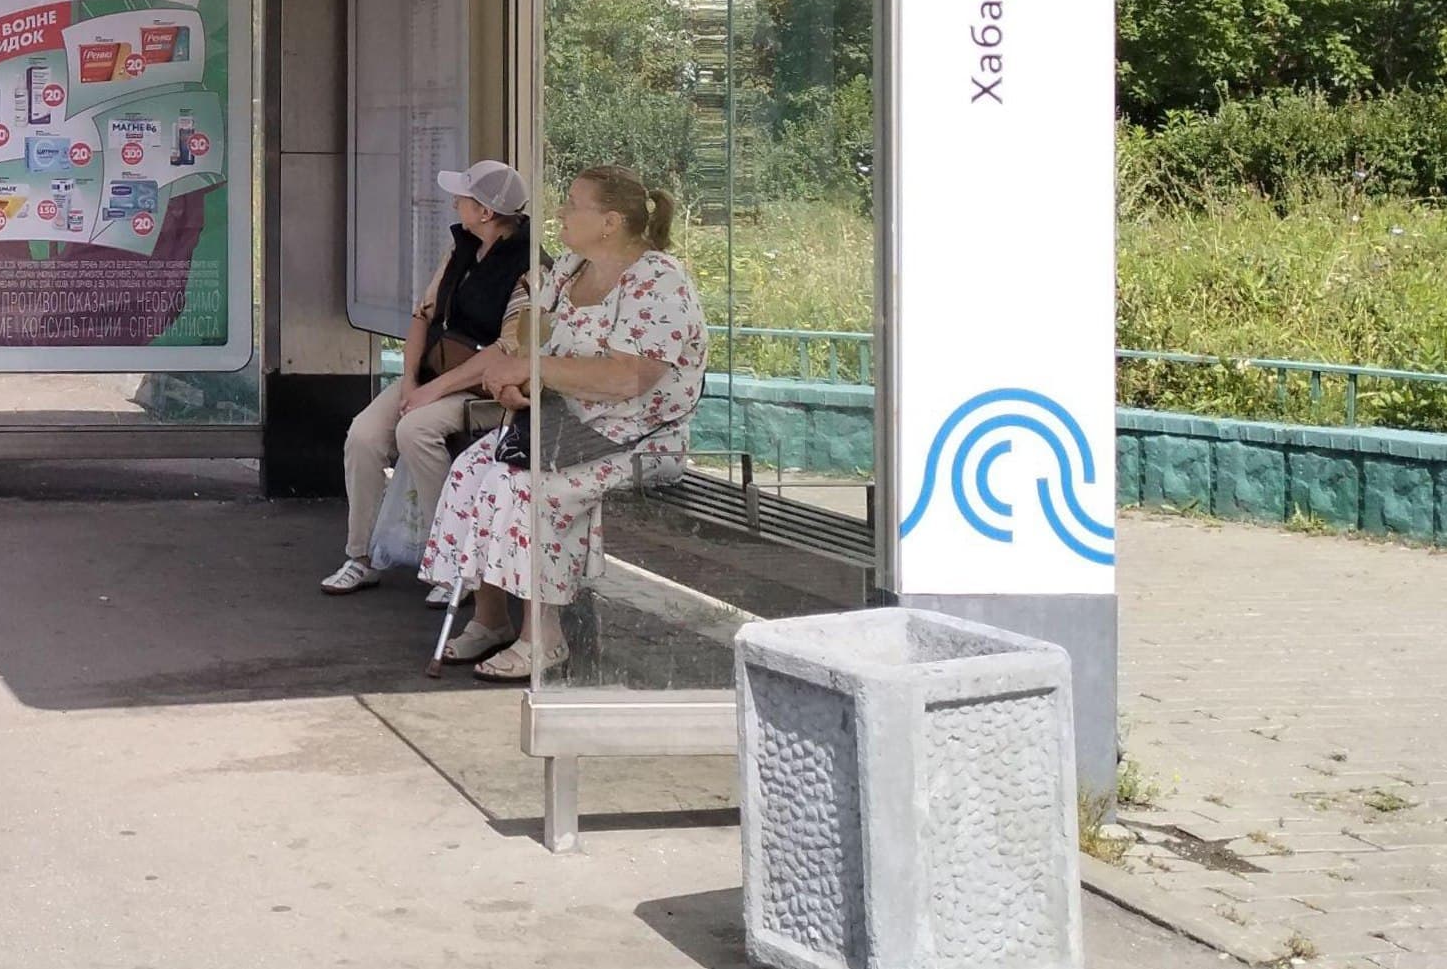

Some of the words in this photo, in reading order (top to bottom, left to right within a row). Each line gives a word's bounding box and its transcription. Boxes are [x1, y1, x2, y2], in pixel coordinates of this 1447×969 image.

[1, 10, 58, 37] ВОЛНЕ
[136, 289, 221, 313] НЕОБХОДИМО
[21, 316, 121, 339] КОНСУЛЬТАЦИИ
[129, 316, 220, 338] СПЕЦИАЛИСТА
